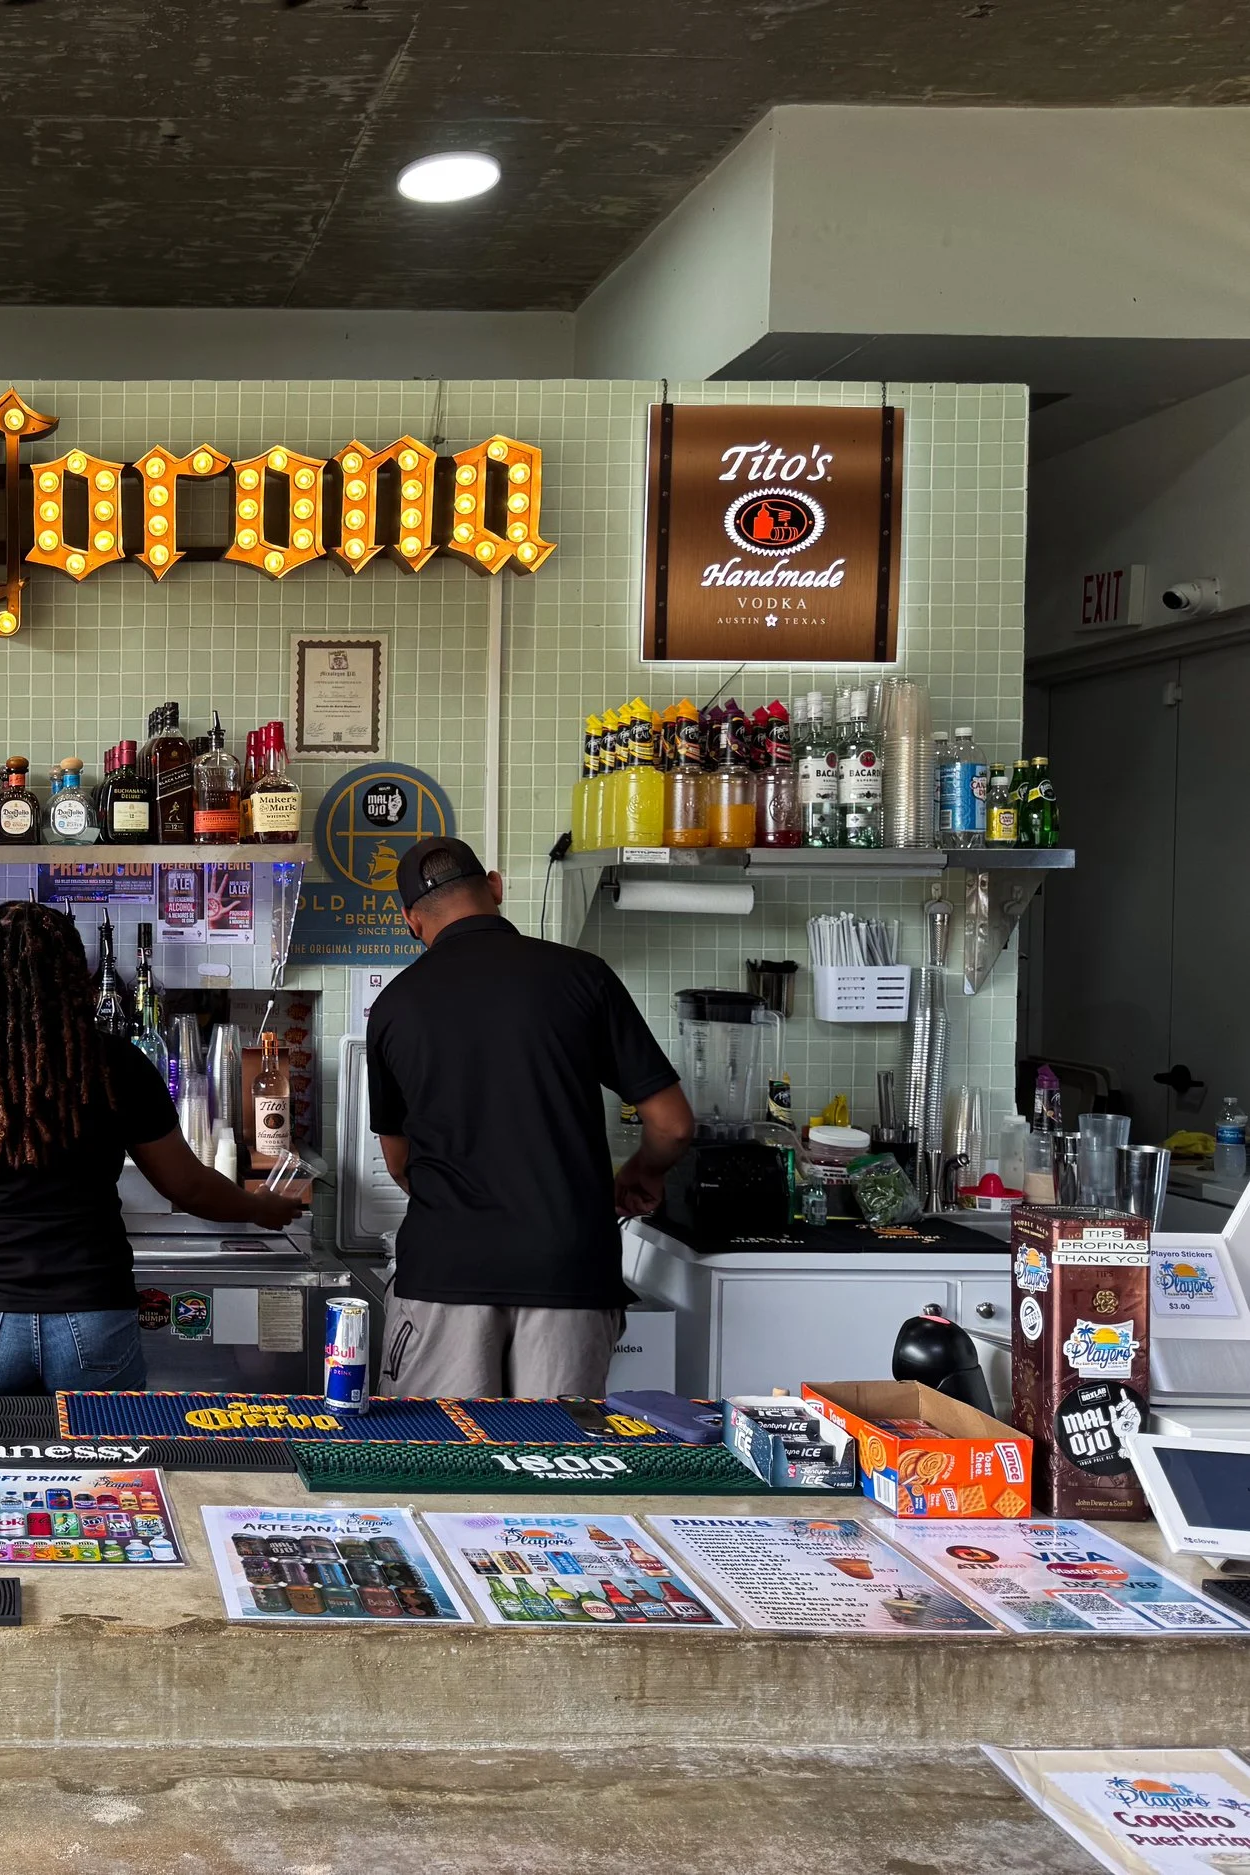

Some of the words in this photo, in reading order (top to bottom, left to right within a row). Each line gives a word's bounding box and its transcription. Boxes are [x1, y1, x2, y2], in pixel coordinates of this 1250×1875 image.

[719, 441, 833, 482] Tito's
[701, 557, 846, 588] Handmade
[1082, 570, 1123, 624] EXIT
[737, 597, 807, 610] VODKA
[717, 617, 760, 625] AUSTIN
[784, 617, 826, 625] TEXAS
[259, 795, 297, 804] Maker's
[368, 795, 389, 804] MAL
[268, 804, 297, 812] Mark
[168, 879, 179, 890] LA
[180, 879, 195, 890] LEY
[230, 885, 238, 894] LA
[239, 885, 250, 894] LEY
[169, 903, 195, 911] ALCOHOL
[357, 927, 387, 935] SINCE
[309, 944, 352, 953] ORIGINAL
[356, 944, 390, 953] PUERTO
[394, 944, 423, 953] RICAN
[259, 1100, 287, 1111] Tito's
[1061, 1242, 1147, 1250] PROPINAS
[1054, 1255, 1111, 1263] THANK
[1116, 1256, 1149, 1264] YOU
[1169, 1302, 1190, 1310] $3.00
[185, 1408, 340, 1431] Cuervo
[1062, 1407, 1110, 1434] MAL
[788, 1422, 808, 1431] ICE
[734, 1428, 752, 1458] ICE
[801, 1448, 821, 1457] ICE
[491, 1454, 628, 1475] 1800
[984, 1451, 993, 1476] Toast
[1002, 1444, 1020, 1481] Lance
[534, 1471, 613, 1480] TEQUILA
[801, 1476, 824, 1484] ICE
[1075, 1499, 1090, 1507] John
[259, 1512, 334, 1523] BEERS
[503, 1518, 579, 1527] BEERS
[670, 1518, 773, 1528] DRINKS
[242, 1523, 382, 1535] ARTESANALES
[1045, 1540, 1067, 1548] Pay
[1017, 1552, 1114, 1562] VISA
[1051, 1567, 1124, 1576] MasterCard
[1062, 1581, 1163, 1590] DISCOVER
[1113, 1812, 1236, 1832] Coquito
